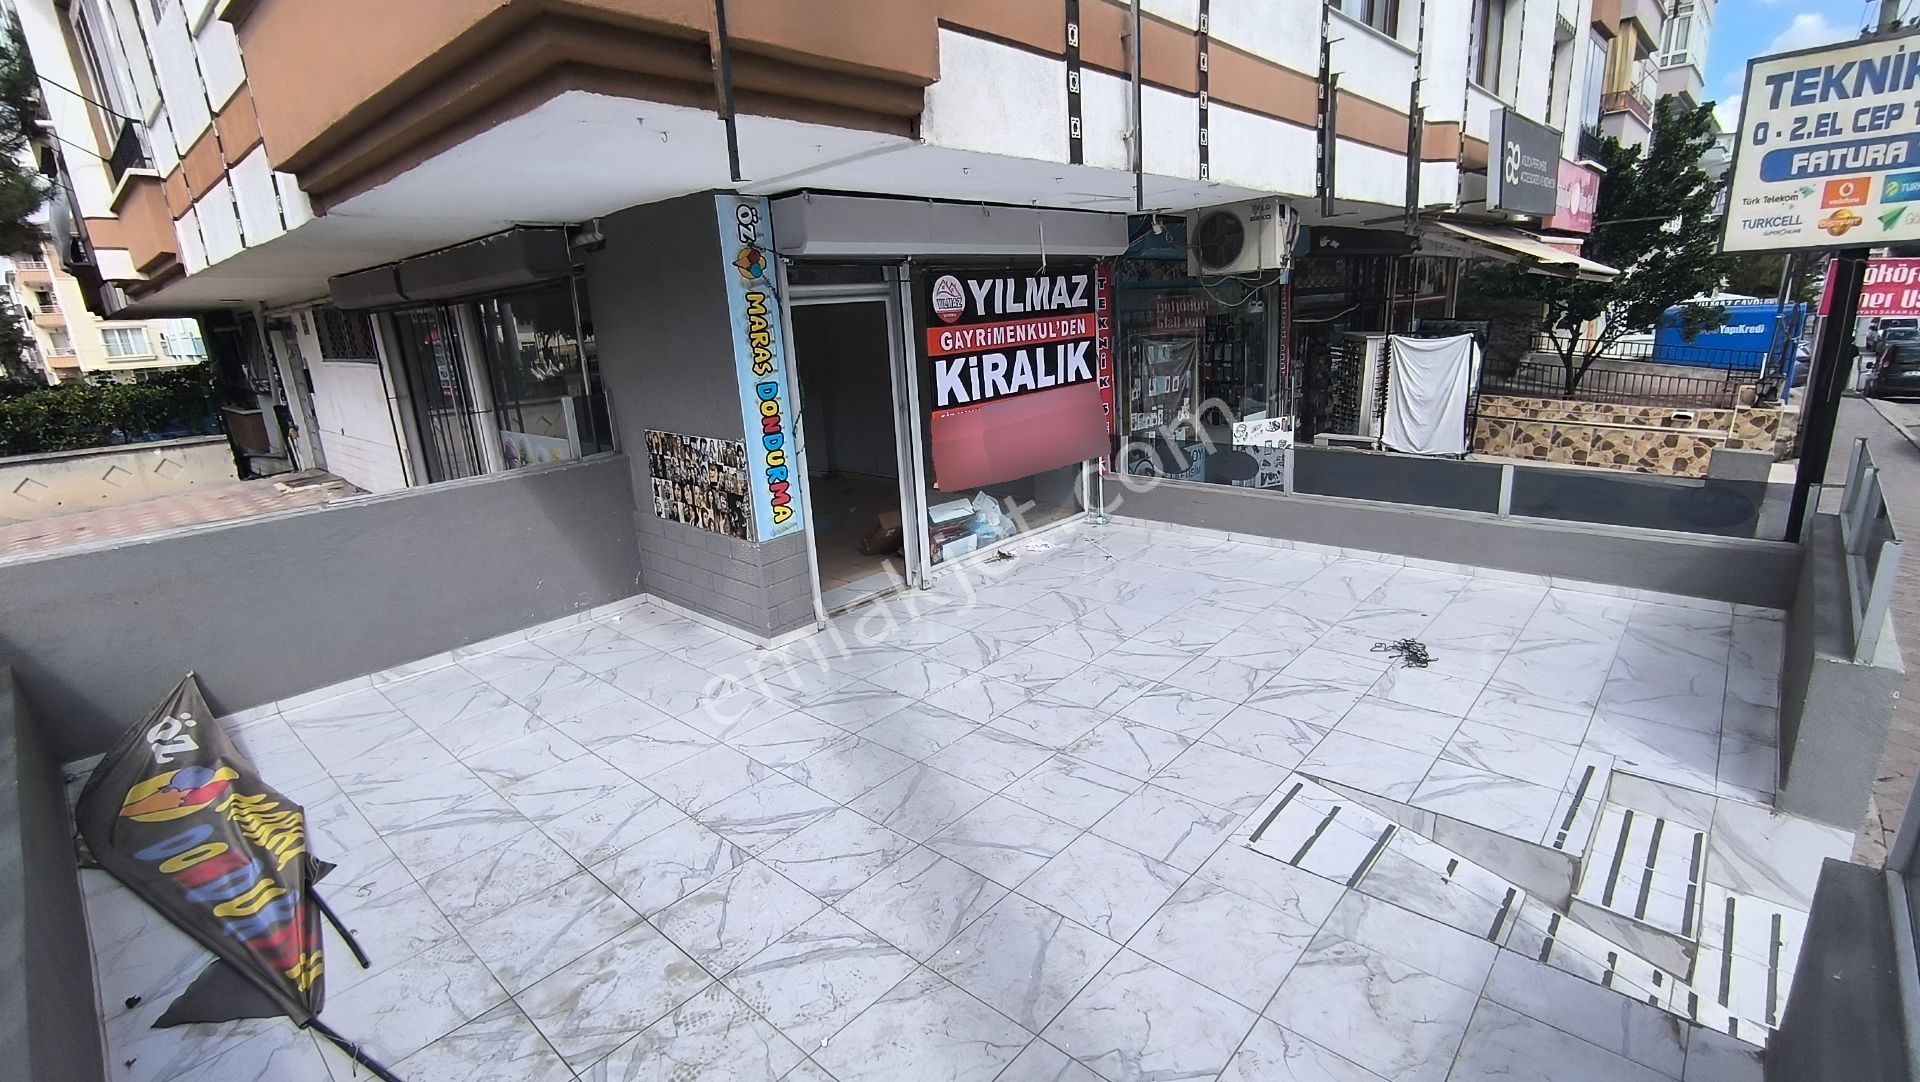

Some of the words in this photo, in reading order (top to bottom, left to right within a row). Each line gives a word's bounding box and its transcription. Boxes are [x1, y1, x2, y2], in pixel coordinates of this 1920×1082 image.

[1852, 103, 1904, 133] CEP
[1791, 141, 1908, 175] FATURA
[1763, 193, 1799, 204] Telekom
[1741, 214, 1803, 230] TURKCELL
[1862, 264, 1920, 286] ğköf
[936, 297, 963, 310] YILMAZ
[967, 275, 1089, 316] YILMAZ
[1857, 292, 1897, 309] ner
[1720, 324, 1765, 335] YapıKredi
[736, 204, 759, 244] ÖZ
[756, 381, 794, 524] DONDURMA
[146, 712, 198, 764] ÖZ
